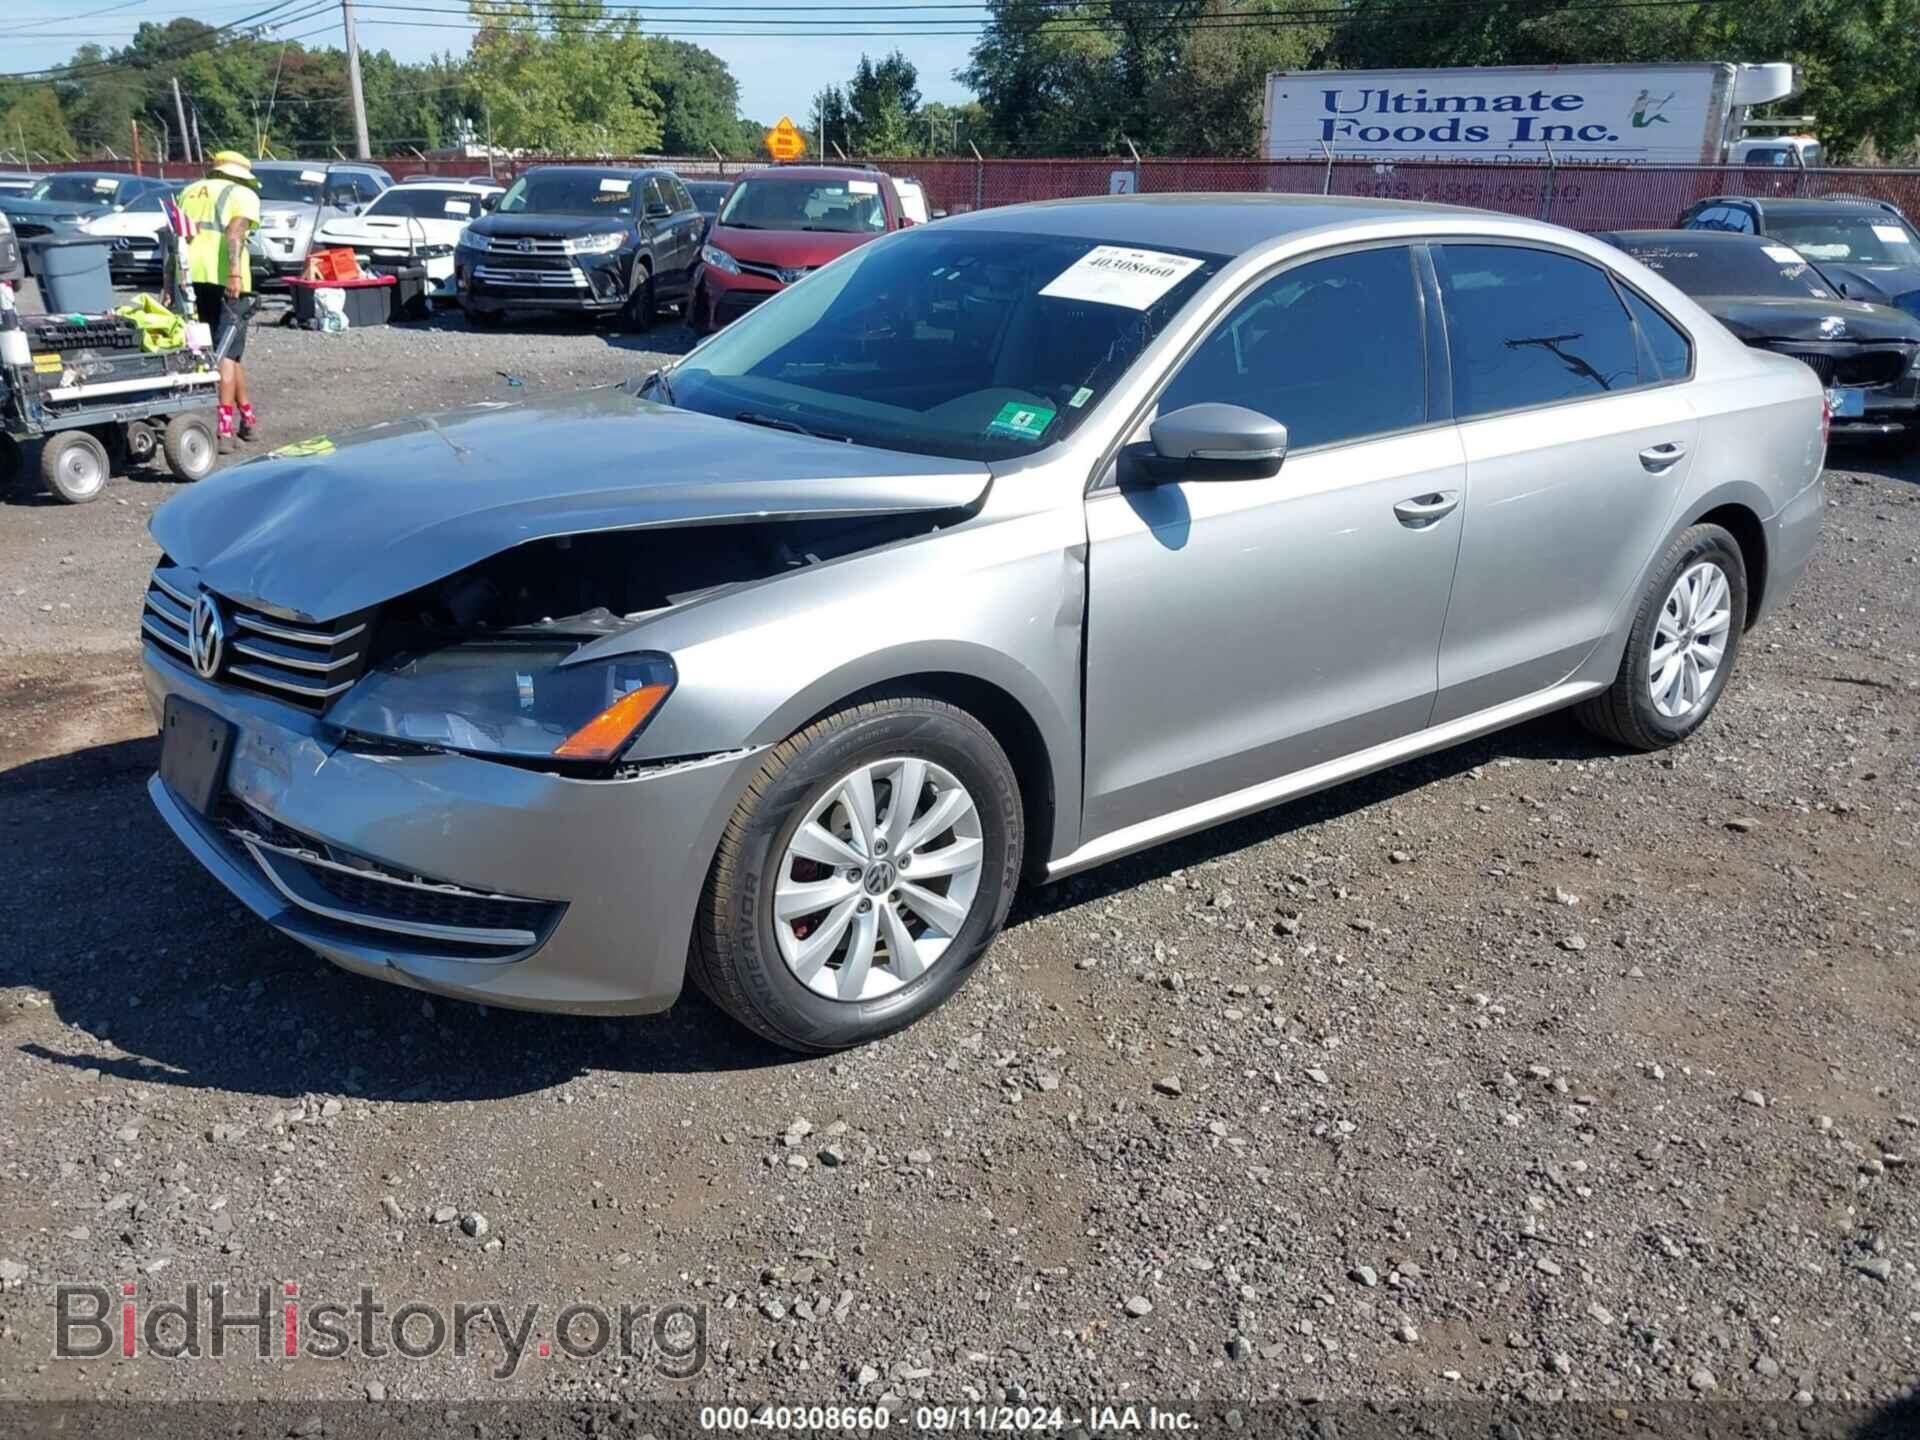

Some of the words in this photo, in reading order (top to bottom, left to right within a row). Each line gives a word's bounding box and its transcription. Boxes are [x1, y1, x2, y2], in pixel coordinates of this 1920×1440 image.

[1320, 88, 1585, 114] Ultimate
[1318, 117, 1490, 143] Foods
[1507, 116, 1620, 143] Inc.
[1089, 257, 1176, 278] 40308660
